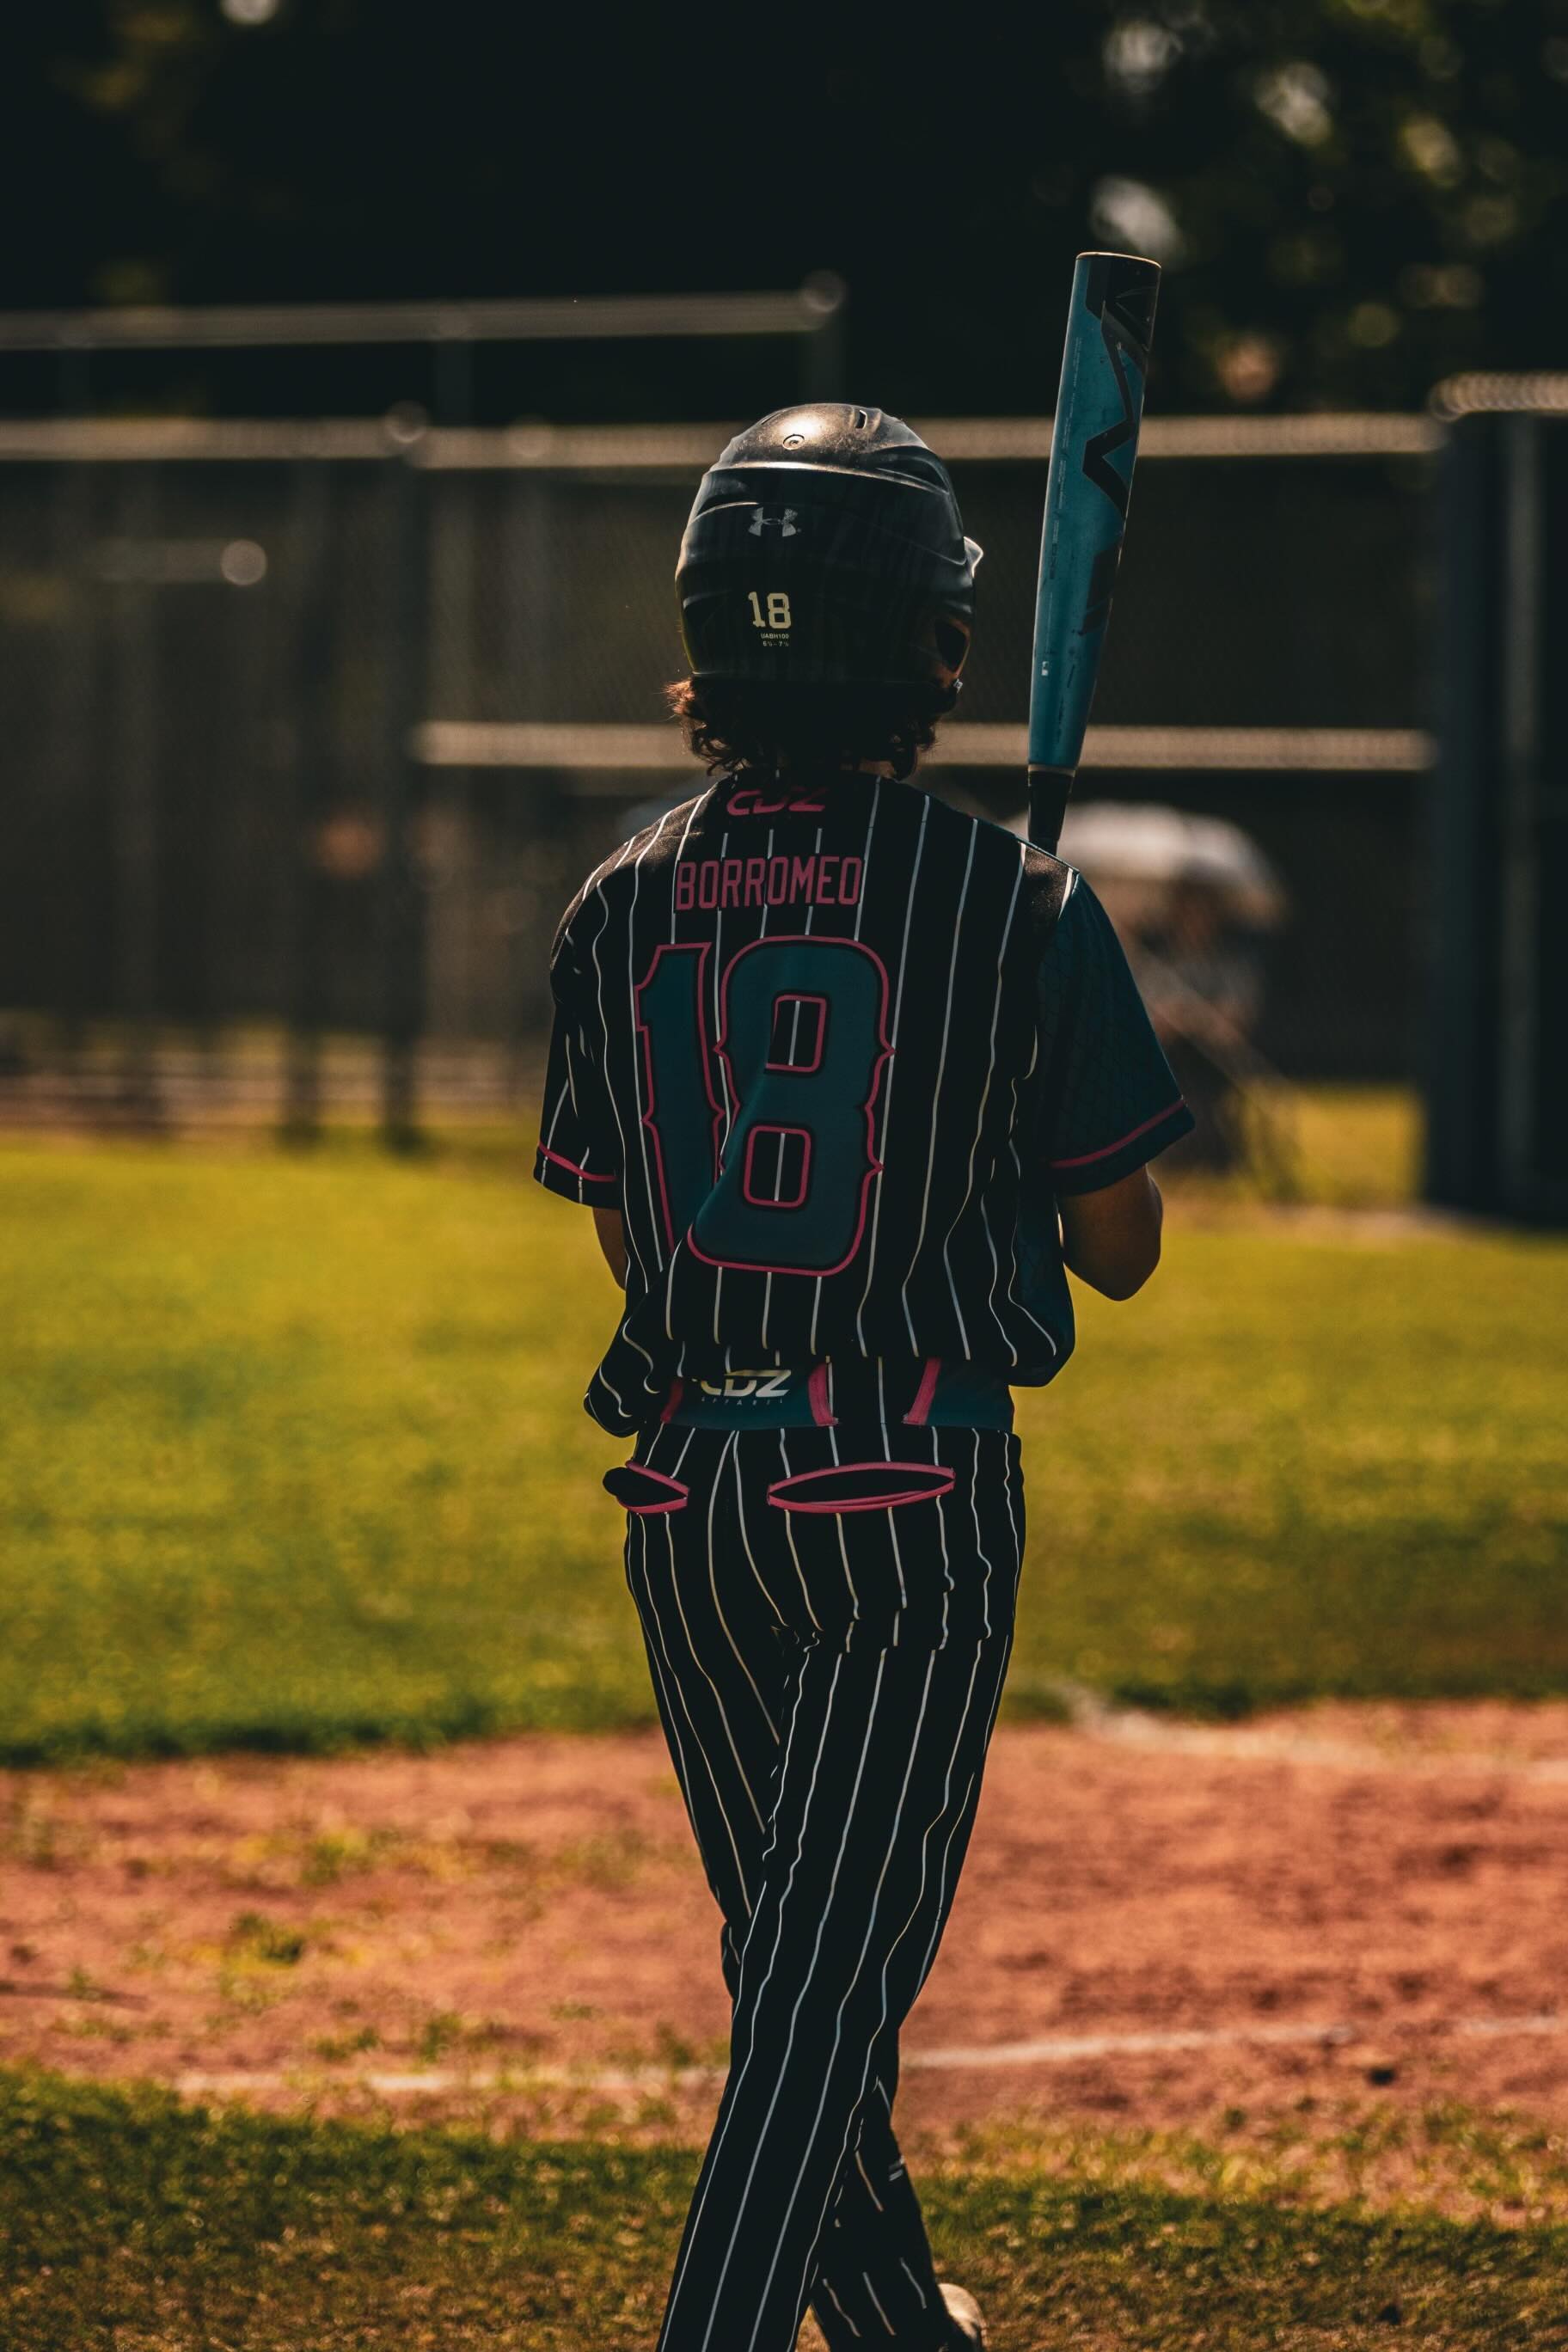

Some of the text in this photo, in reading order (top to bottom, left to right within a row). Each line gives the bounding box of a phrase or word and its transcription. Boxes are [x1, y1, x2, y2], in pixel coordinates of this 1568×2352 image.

[747, 591, 792, 629] 18
[675, 855, 863, 911] BORROMEO
[634, 934, 896, 1277] 18
